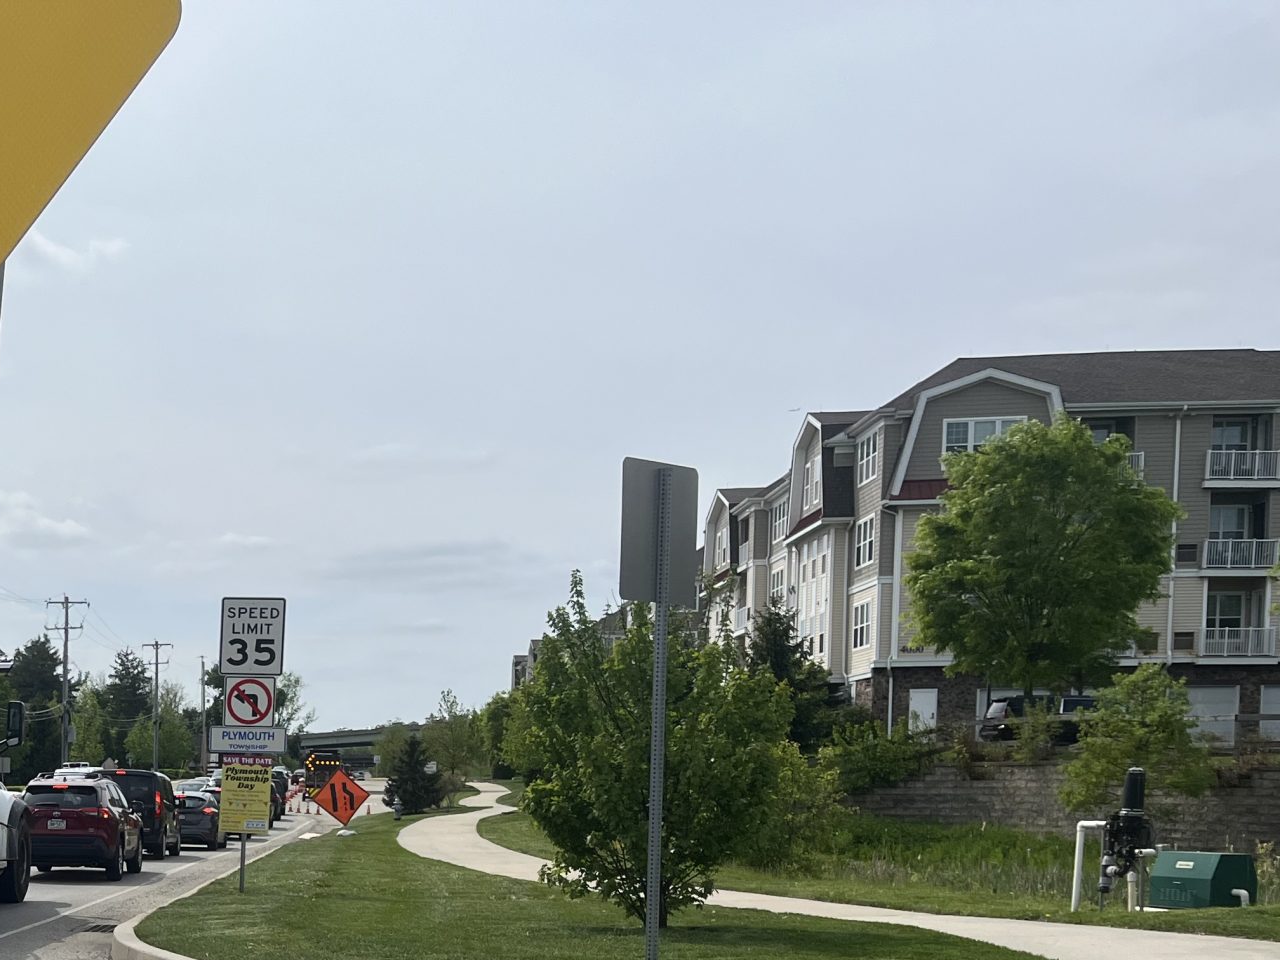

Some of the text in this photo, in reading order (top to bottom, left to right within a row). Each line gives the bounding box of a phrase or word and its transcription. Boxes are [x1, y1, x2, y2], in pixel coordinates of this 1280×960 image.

[227, 607, 280, 619] SPEED
[232, 623, 273, 635] LIMIT
[226, 638, 276, 666] 35
[222, 731, 275, 741] PLYMOUTH
[223, 756, 239, 764] SAVE
[225, 766, 269, 776] Plymouth
[225, 775, 269, 783] Township
[237, 782, 255, 791] Day
